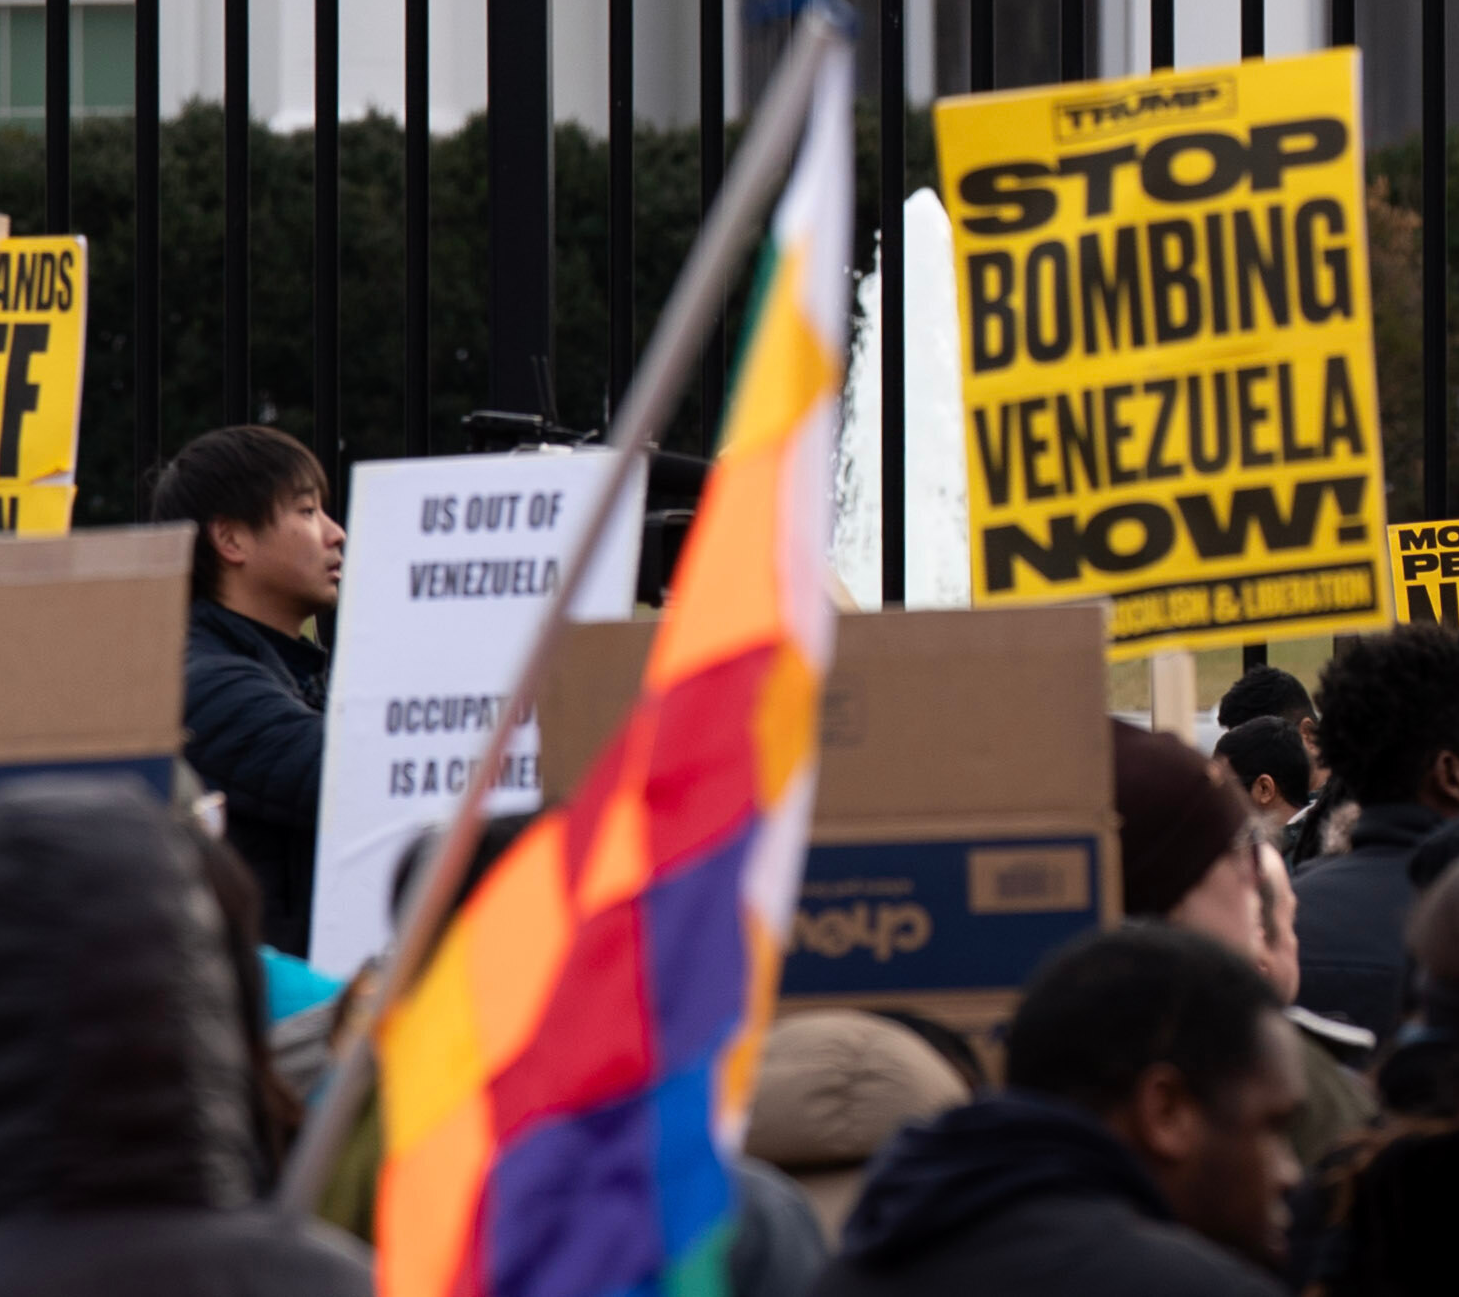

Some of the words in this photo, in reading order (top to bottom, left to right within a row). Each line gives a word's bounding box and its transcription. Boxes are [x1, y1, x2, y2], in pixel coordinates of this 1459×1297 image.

[1064, 86, 1220, 130] TRUMP
[958, 116, 1349, 236] STOP
[967, 195, 1355, 375] BOMBING
[973, 355, 1365, 508] VENEZUELA
[421, 496, 457, 535] US
[465, 493, 522, 533] OUT
[527, 490, 564, 531] OF
[982, 474, 1368, 594] NOW!
[1213, 582, 1240, 623] &
[1242, 567, 1374, 619] LIBERATION
[389, 760, 416, 797] IS
[421, 759, 440, 793] A
